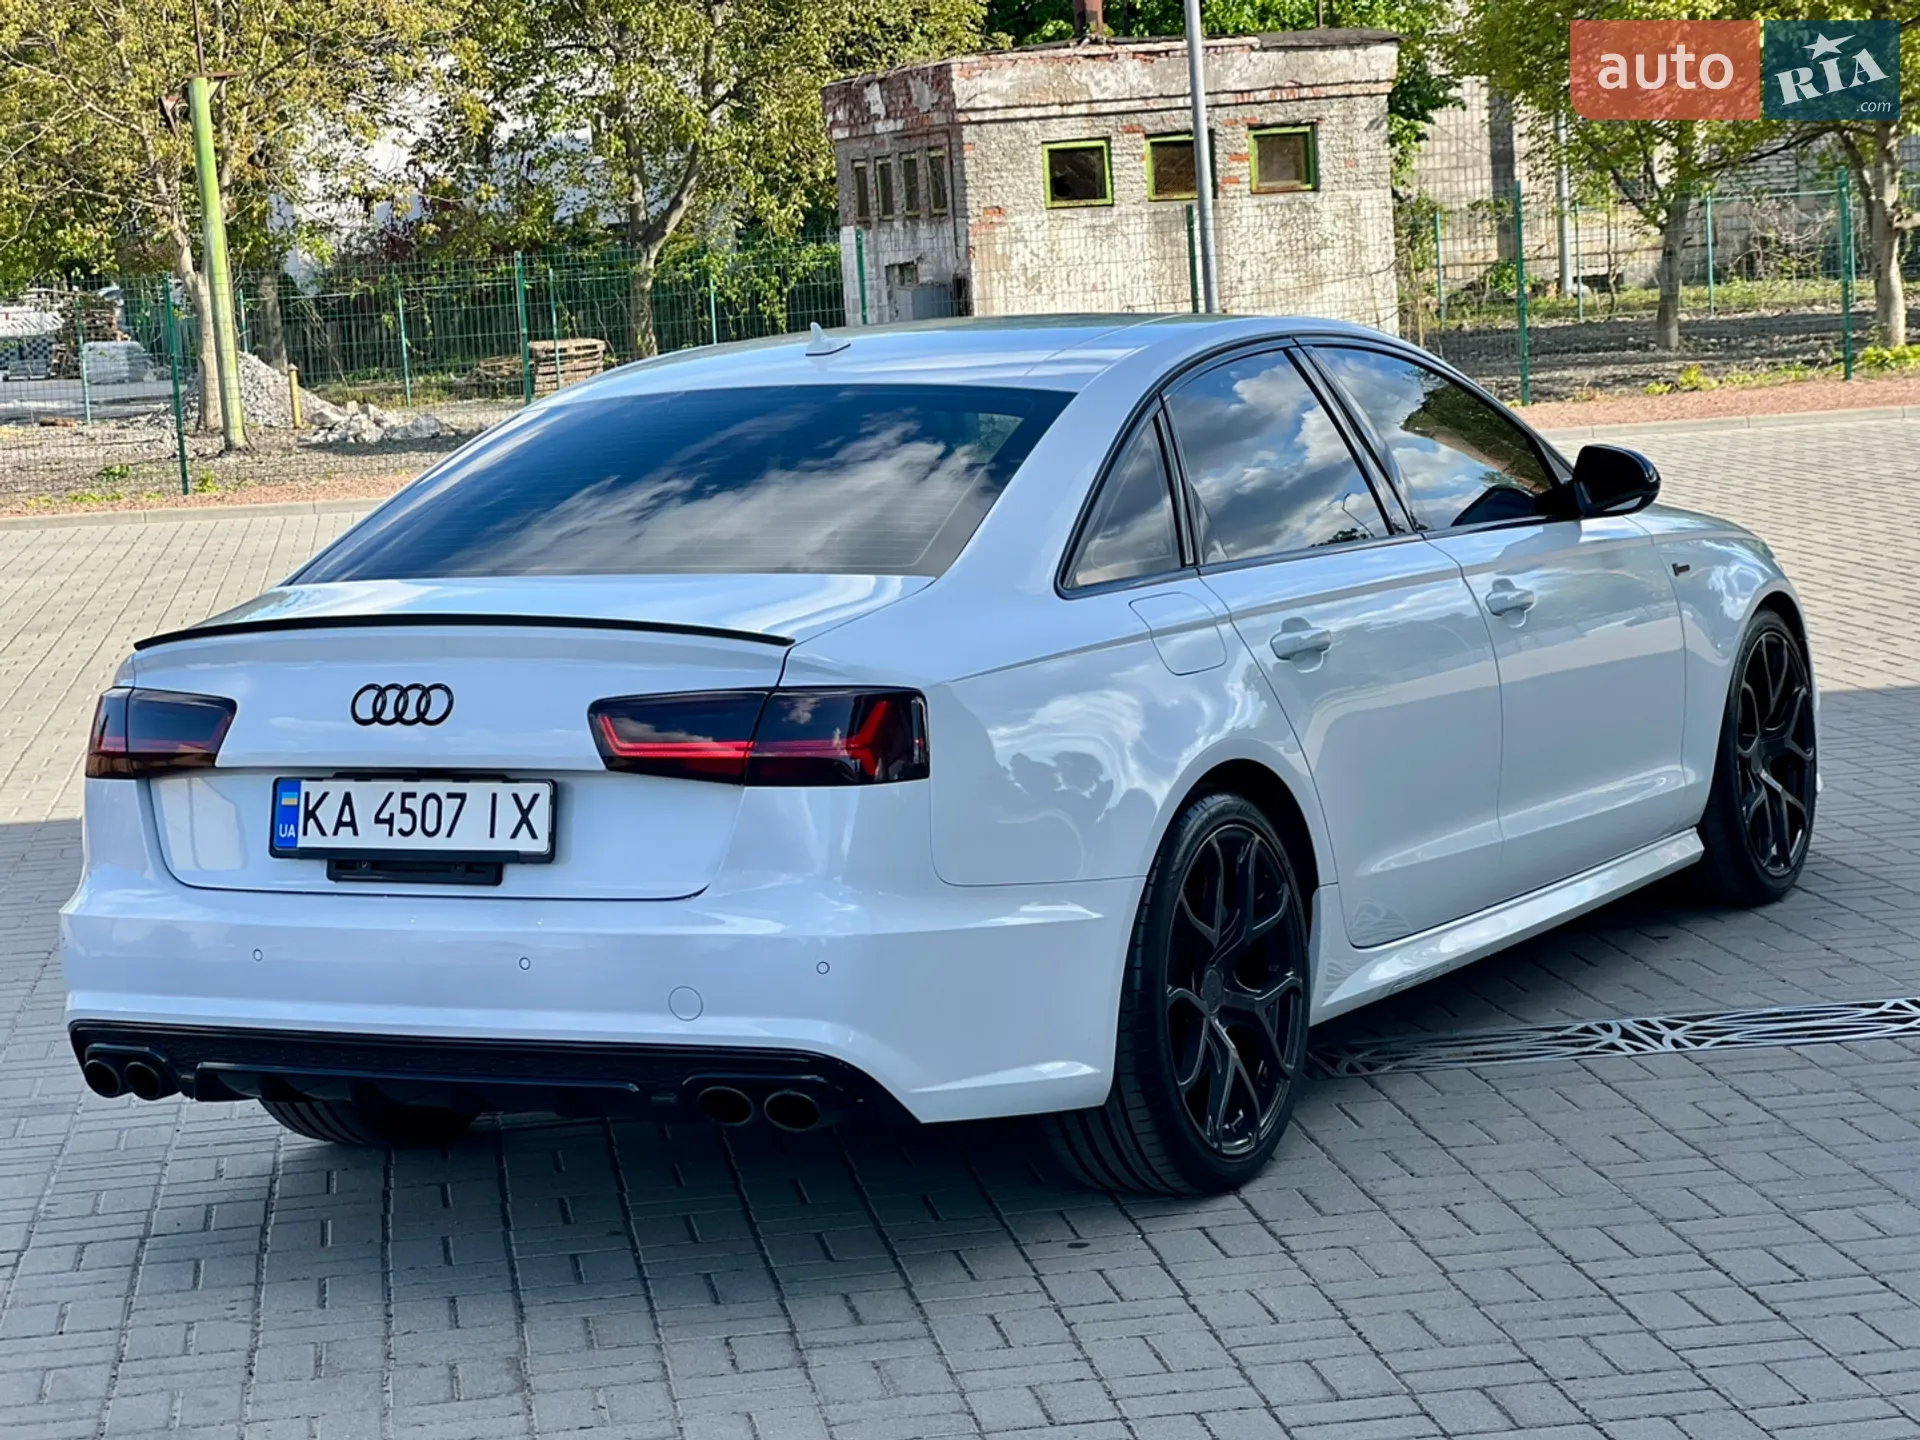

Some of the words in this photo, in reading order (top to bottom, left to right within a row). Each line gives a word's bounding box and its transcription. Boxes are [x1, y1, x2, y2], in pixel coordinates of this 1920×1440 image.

[278, 823, 296, 838] UA
[302, 791, 359, 837] KA
[373, 791, 467, 838] 4507
[489, 792, 540, 840] IX
